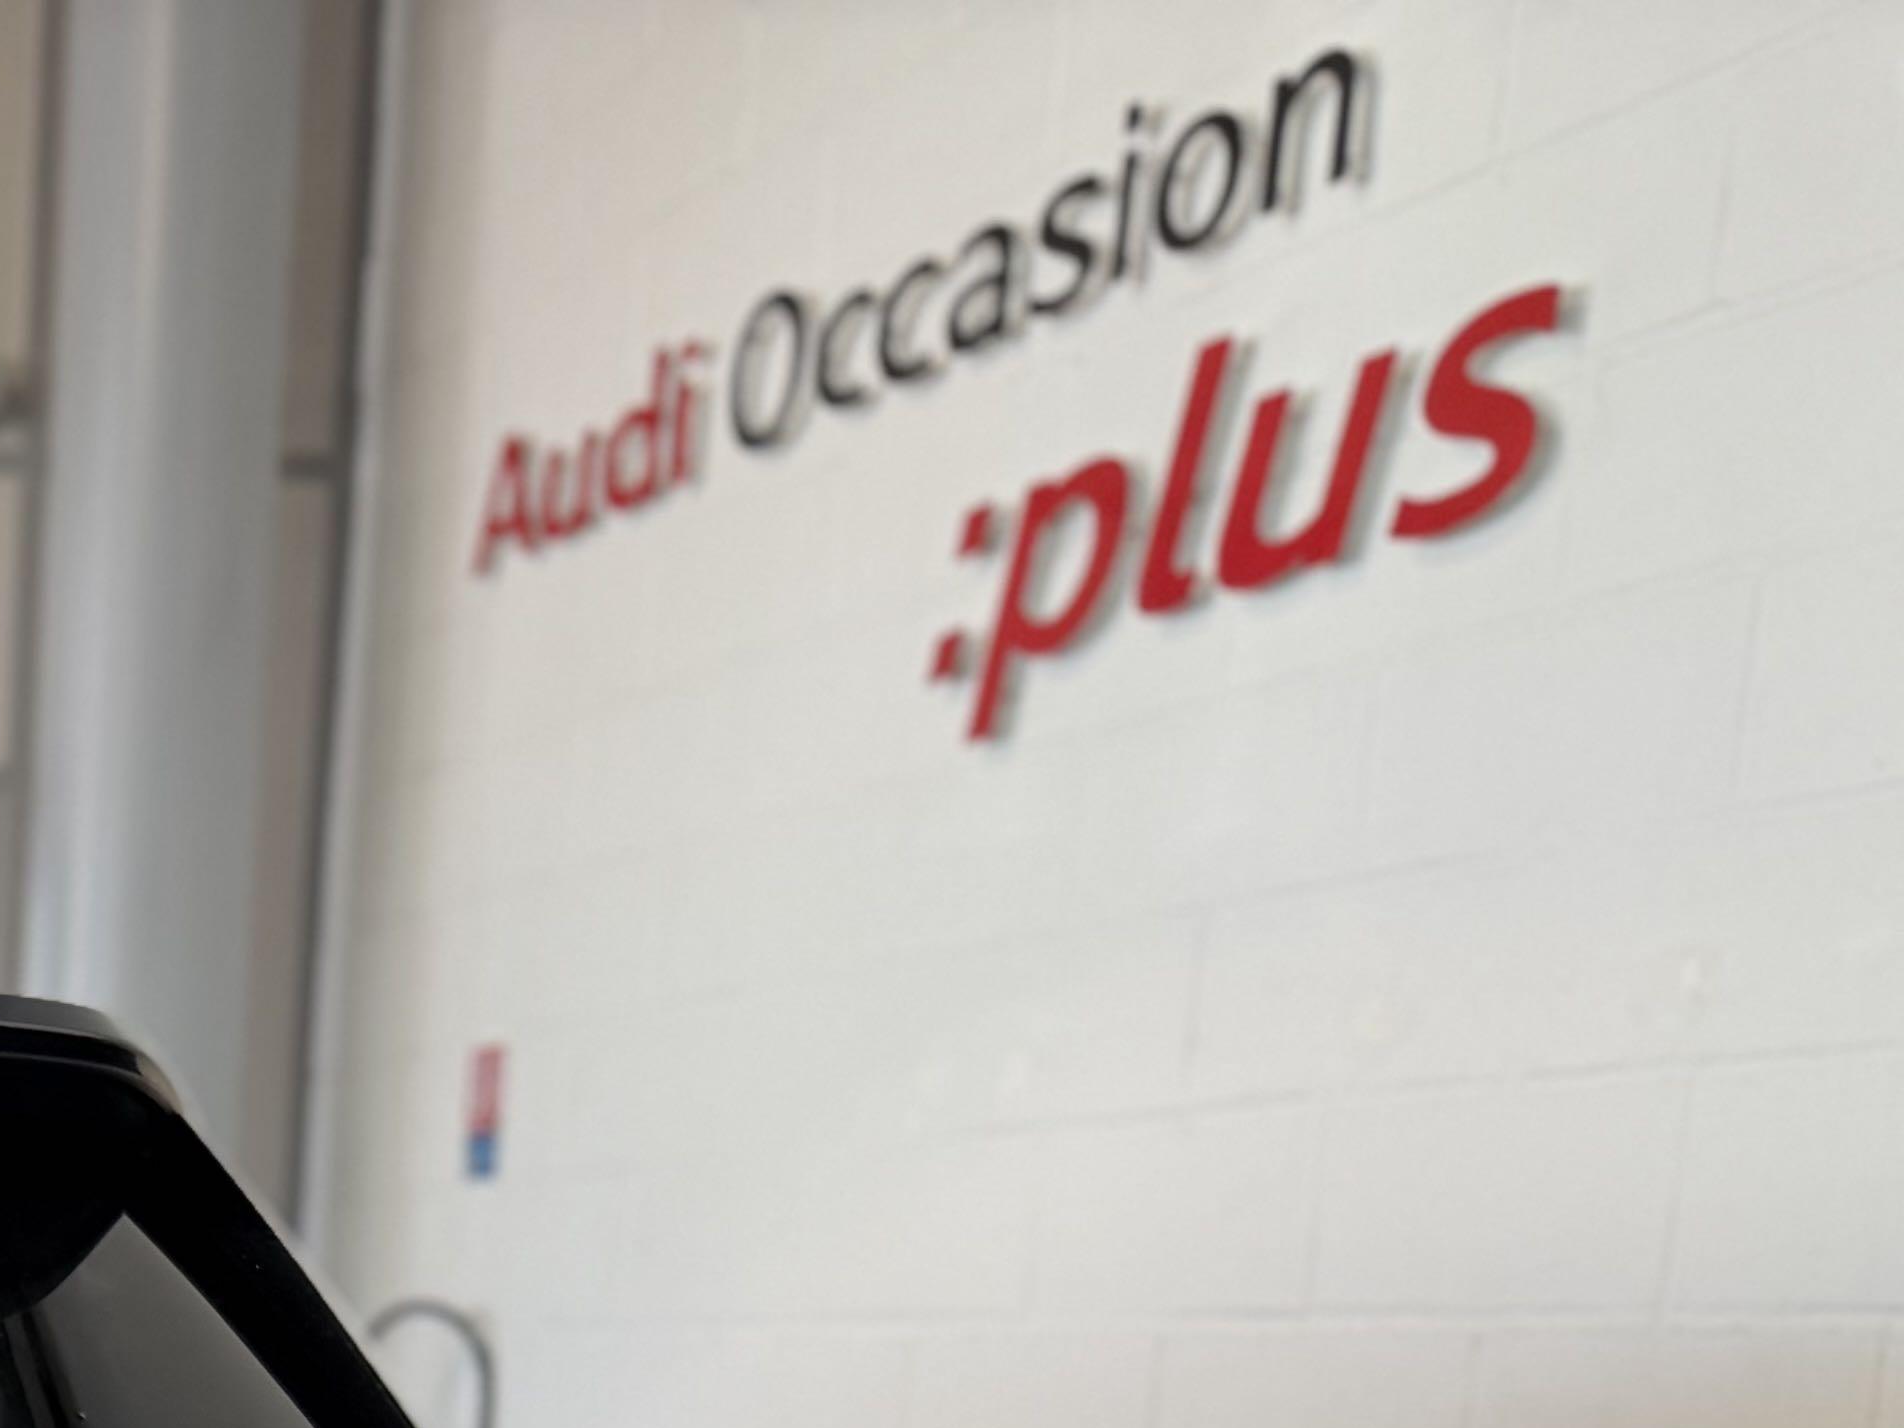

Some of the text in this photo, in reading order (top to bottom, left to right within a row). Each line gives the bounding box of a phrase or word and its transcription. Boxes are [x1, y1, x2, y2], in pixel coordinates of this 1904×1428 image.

[472, 44, 1362, 578] Audi Occasion
[928, 284, 1566, 744] :plus
